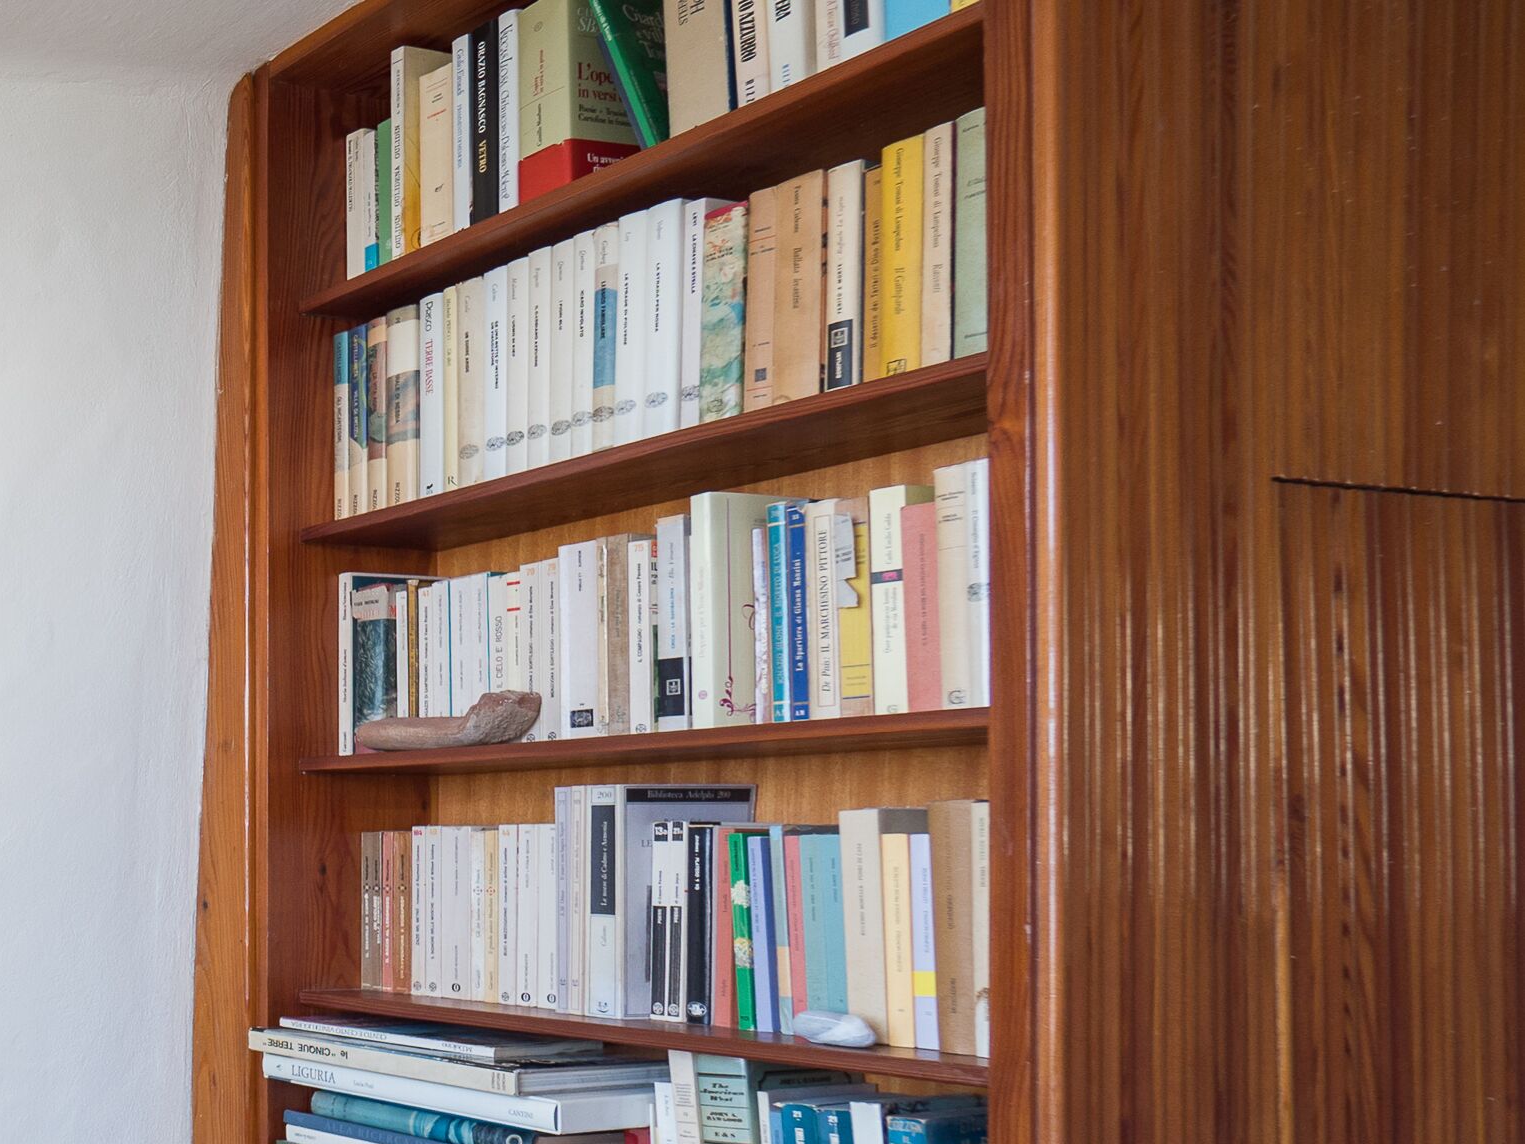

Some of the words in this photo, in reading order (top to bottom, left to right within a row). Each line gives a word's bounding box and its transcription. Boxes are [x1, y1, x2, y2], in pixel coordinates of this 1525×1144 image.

[739, 13, 757, 62] AZZURRO
[477, 41, 486, 78] ORAZIO
[477, 80, 486, 133] BAGNASCO
[479, 140, 487, 173] VETRO
[893, 147, 904, 178] Giuseppe
[931, 137, 942, 168] Giuseppe
[895, 181, 904, 205] Tomasi
[933, 173, 943, 197] Tomasi
[933, 201, 942, 209] di
[893, 216, 903, 251] Lampedusa
[931, 211, 942, 248] Lampedusa
[793, 247, 802, 274] Ballata
[871, 248, 880, 264] Dino
[894, 267, 905, 275] Il
[871, 274, 879, 298] Tartari
[891, 276, 904, 315] Gattopardo
[870, 300, 879, 312] dei
[870, 315, 879, 340] deserto
[425, 339, 433, 368] TERRE
[425, 369, 433, 396] BASSE
[884, 513, 892, 531] Gadda
[818, 529, 828, 571] PITTORE
[884, 532, 892, 549] Emilio
[885, 551, 893, 565] Carlo
[793, 559, 802, 586] Manzini
[794, 589, 803, 614] Gianna
[819, 575, 830, 639] MARCHESINO
[495, 616, 503, 642] ROSSO
[794, 625, 804, 660] Sparviera
[821, 644, 831, 653] IL
[794, 662, 804, 671] La
[822, 680, 831, 692] De
[647, 790, 683, 799] Biblioteca
[686, 790, 715, 800] Adelphi
[600, 821, 608, 846] Armonia
[600, 852, 608, 872] Cadmo
[600, 898, 608, 906] Le
[340, 1050, 348, 1059] le
[291, 1064, 336, 1085] LIGURIA
[324, 1118, 353, 1134] ALLA
